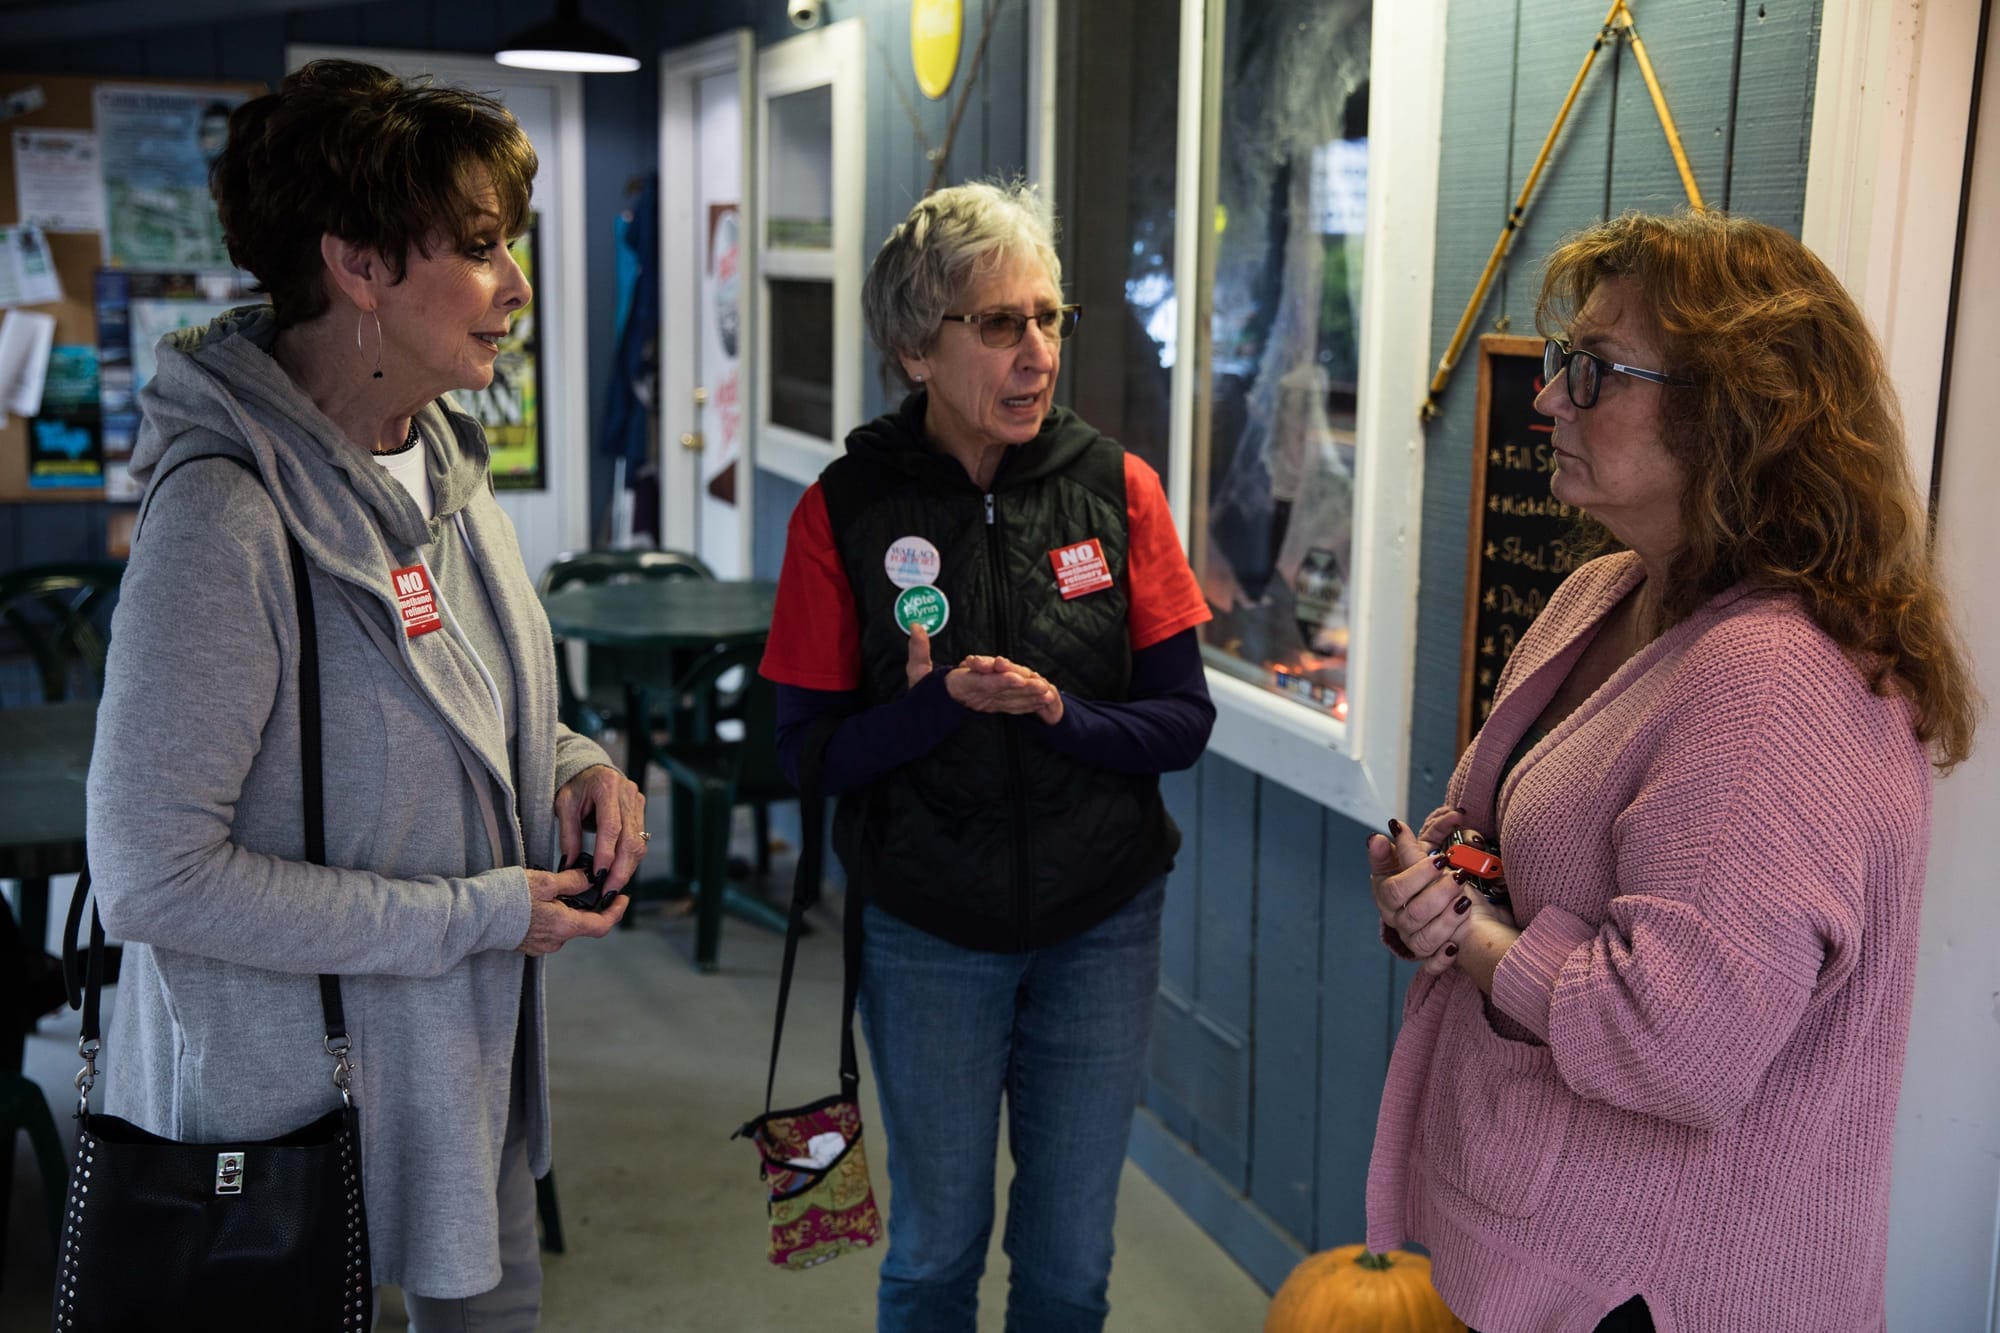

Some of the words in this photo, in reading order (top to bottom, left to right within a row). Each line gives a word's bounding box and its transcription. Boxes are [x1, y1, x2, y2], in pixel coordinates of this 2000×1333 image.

[1504, 444, 1532, 471] Full
[1060, 544, 1095, 567] NO
[396, 571, 424, 595] NO
[902, 595, 936, 607] Vote
[904, 604, 939, 618] Flynn
